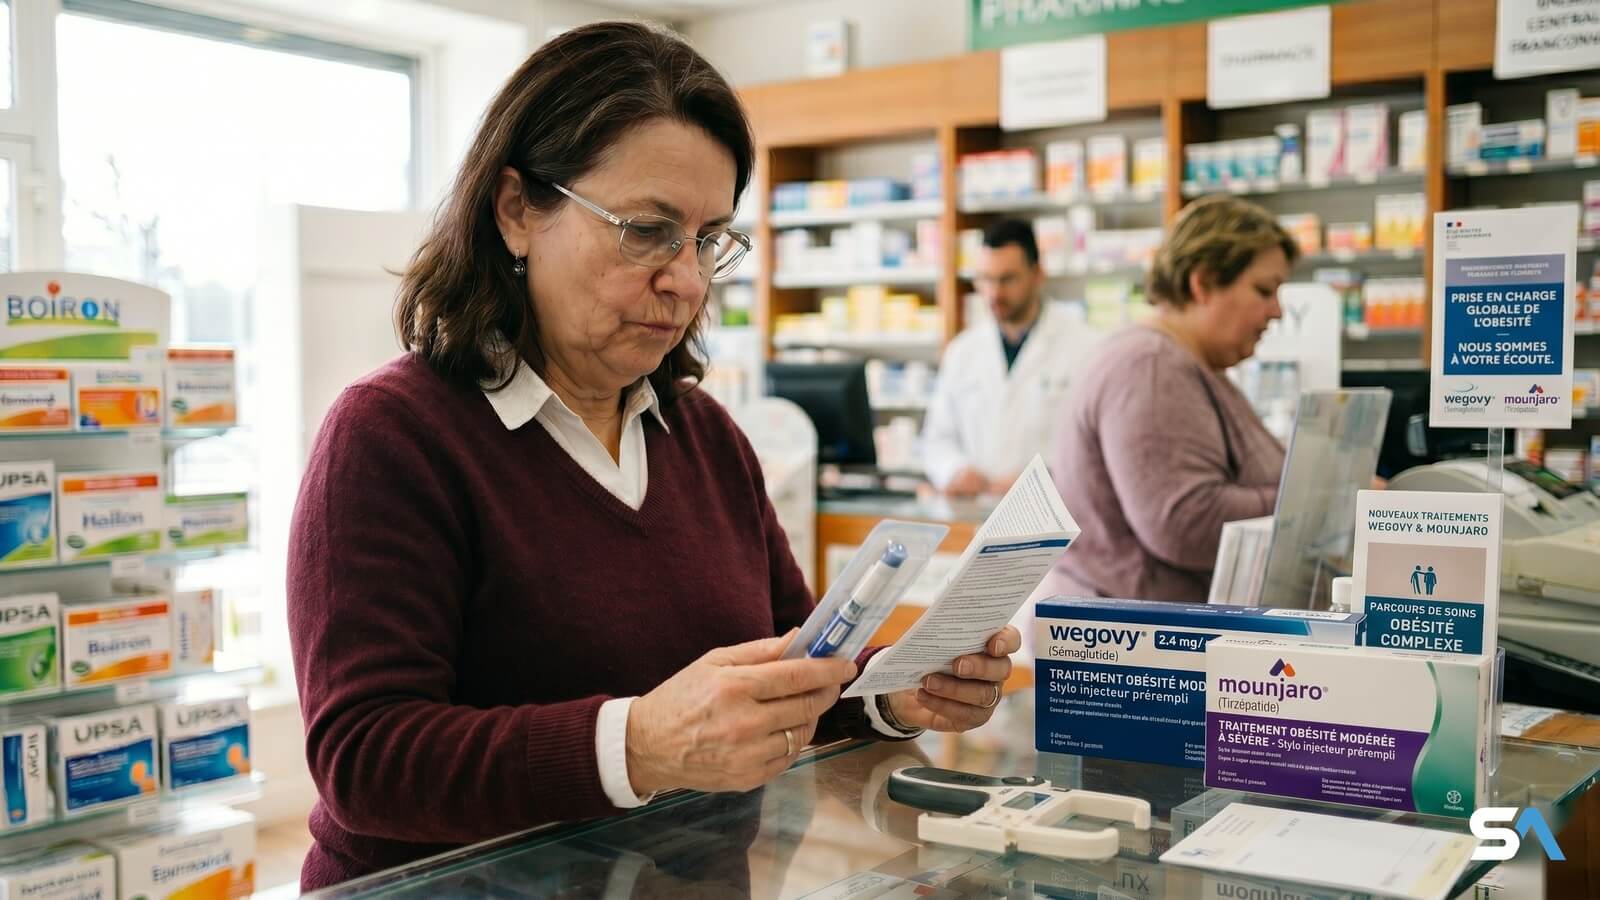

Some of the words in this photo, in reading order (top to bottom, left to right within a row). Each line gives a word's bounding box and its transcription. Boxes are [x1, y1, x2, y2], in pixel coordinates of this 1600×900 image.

[7, 281, 120, 323] BOIRON
[1451, 291, 1484, 303] PRISE
[1486, 292, 1503, 302] EN
[1505, 290, 1557, 302] CHARGE
[1466, 305, 1521, 315] GLOBALE
[1524, 304, 1541, 314] DE
[1458, 343, 1493, 353] NOUS
[1495, 341, 1548, 352] SOMMES
[1451, 355, 1459, 365] À
[1503, 356, 1554, 365] ÉCOUTE.
[1368, 509, 1419, 520] NOUVEAUX
[1421, 511, 1489, 523] TRAITEMENTS
[1368, 522, 1413, 532] WEGOVY
[1415, 523, 1424, 533] &
[1426, 524, 1489, 536] MOUNJARO
[0, 604, 50, 622] PSA
[1370, 602, 1425, 615] PARCOURS
[1428, 606, 1442, 616] DE
[1444, 607, 1477, 618] SOINS
[1390, 616, 1455, 635] OBÉSITÉ
[1159, 635, 1177, 646] 2.4
[1380, 633, 1464, 652] COMPLEXE
[1048, 645, 1119, 662] (Sémaglutide)
[1050, 668, 1124, 685] TRAITEMENT
[1125, 673, 1176, 690] OBÉSITÉ
[1049, 681, 1077, 695] Stylo
[1080, 684, 1130, 700] injecteur
[1132, 689, 1189, 706] prérempli
[1218, 696, 1280, 715] (Tirzépatide)
[176, 705, 239, 727] UPSA
[74, 716, 143, 742] UPSA
[1218, 719, 1288, 737] TRAITEMENT
[1290, 726, 1337, 742] OBÉSITÉ
[1339, 731, 1396, 748] MODÉRÉE
[1218, 729, 1226, 742] À
[1278, 739, 1301, 753] Stylo
[1303, 742, 1345, 757] injecteur
[1347, 746, 1396, 762] prérempli
